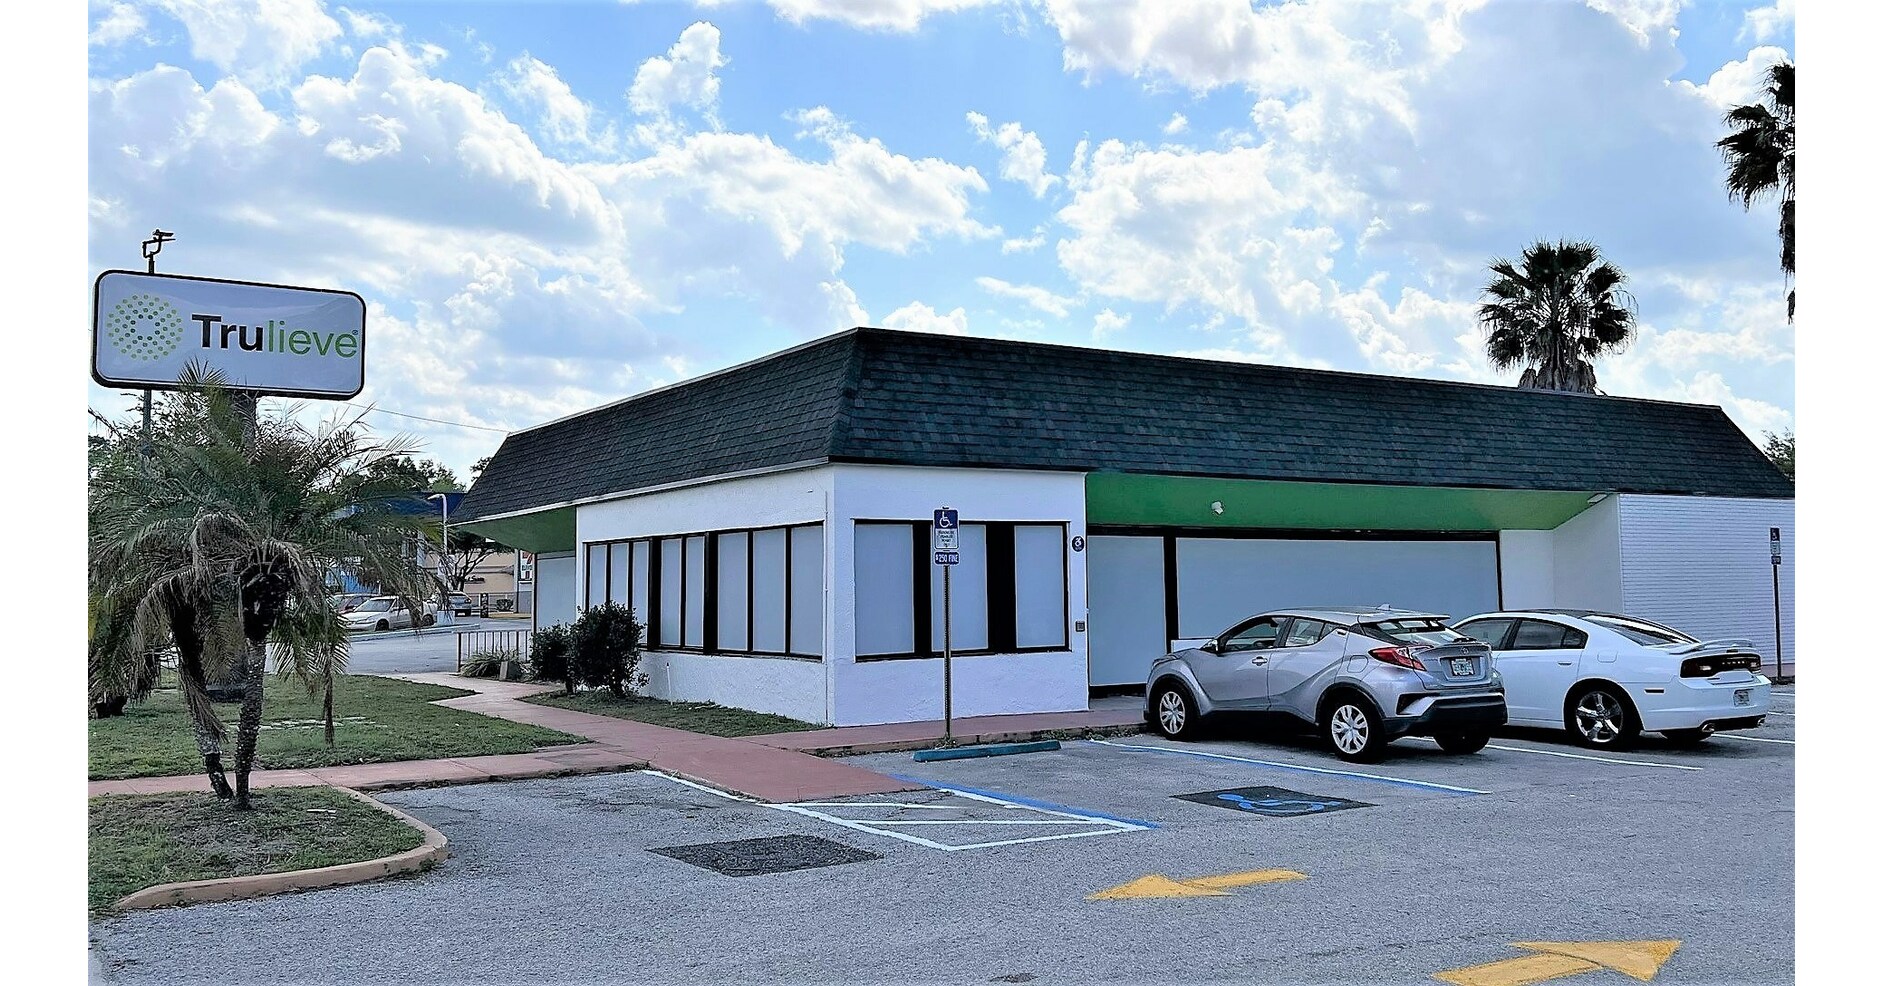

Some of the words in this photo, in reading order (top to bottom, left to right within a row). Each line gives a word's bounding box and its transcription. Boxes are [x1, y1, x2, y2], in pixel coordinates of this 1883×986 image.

[191, 314, 358, 358] Trulieve
[935, 554, 948, 562] $250
[948, 554, 959, 562] FINE
